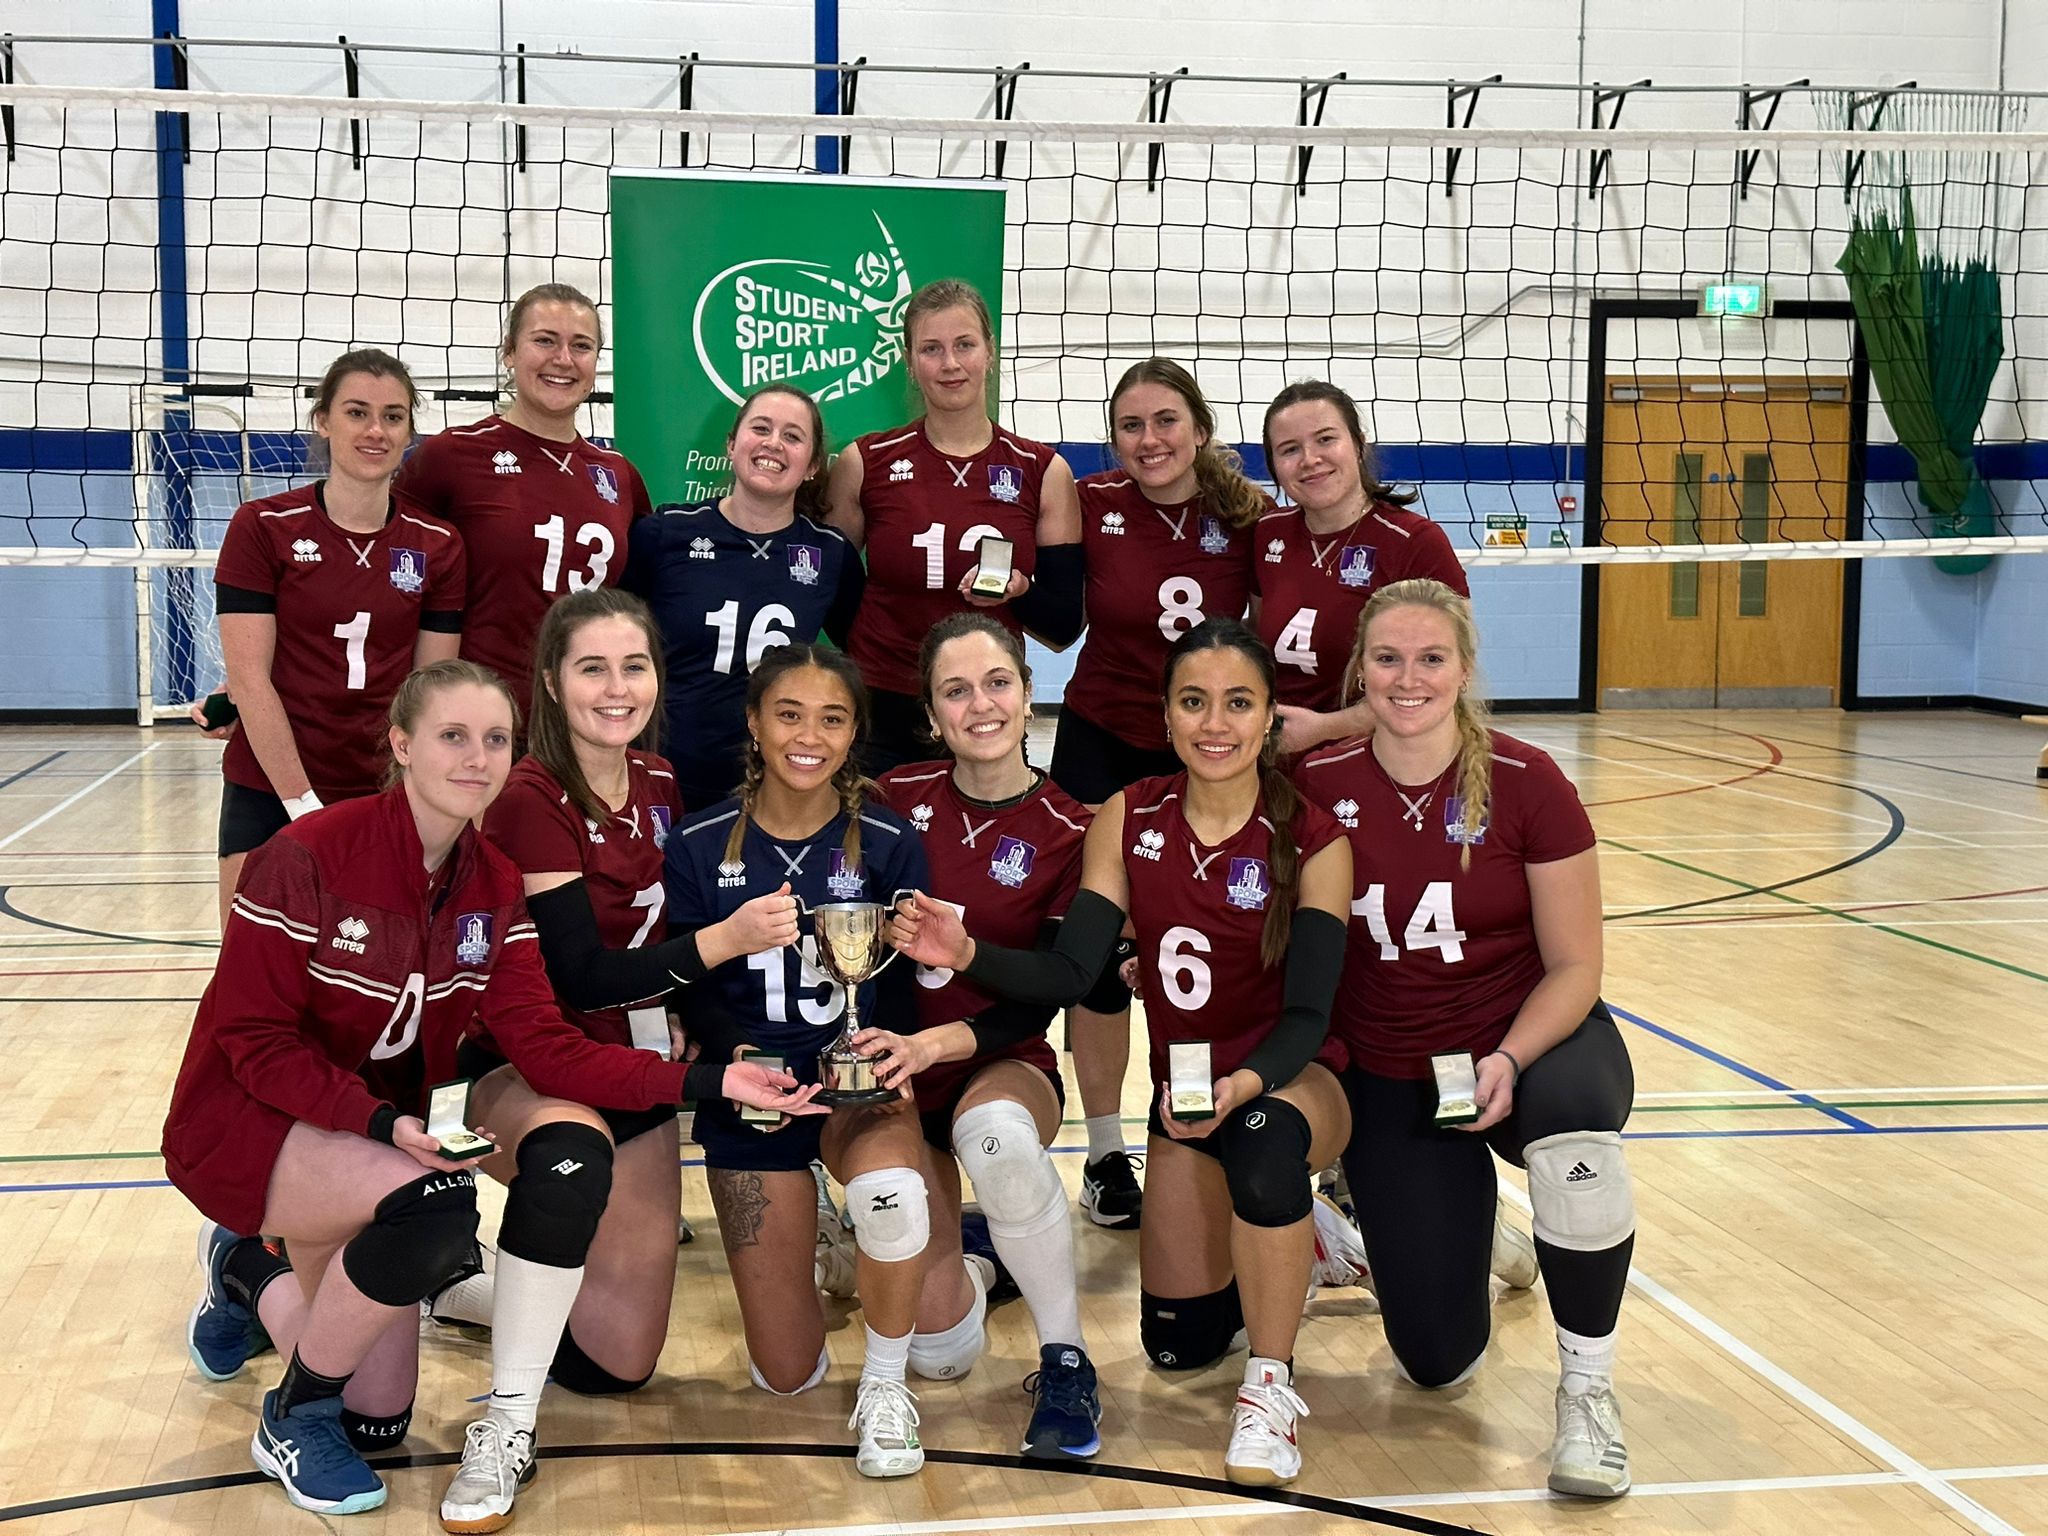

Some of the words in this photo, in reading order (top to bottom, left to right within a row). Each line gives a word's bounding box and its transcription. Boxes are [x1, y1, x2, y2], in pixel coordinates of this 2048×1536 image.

[735, 275, 863, 324] STUDENT
[735, 313, 829, 350] SPORT
[742, 351, 857, 388] IRELAND
[534, 514, 616, 594] 13
[705, 600, 796, 675] 16
[1158, 576, 1206, 642] 8
[1274, 607, 1319, 676] 4
[333, 611, 371, 690] 1
[718, 875, 746, 888] errea
[1132, 844, 1161, 861] errea
[332, 936, 366, 955] errea
[627, 881, 665, 950] 7
[1351, 881, 1467, 964] 14
[458, 944, 490, 954] SPORT
[747, 935, 846, 1025] 15
[1158, 926, 1212, 1011] 6
[423, 1175, 475, 1196] ALLSIX
